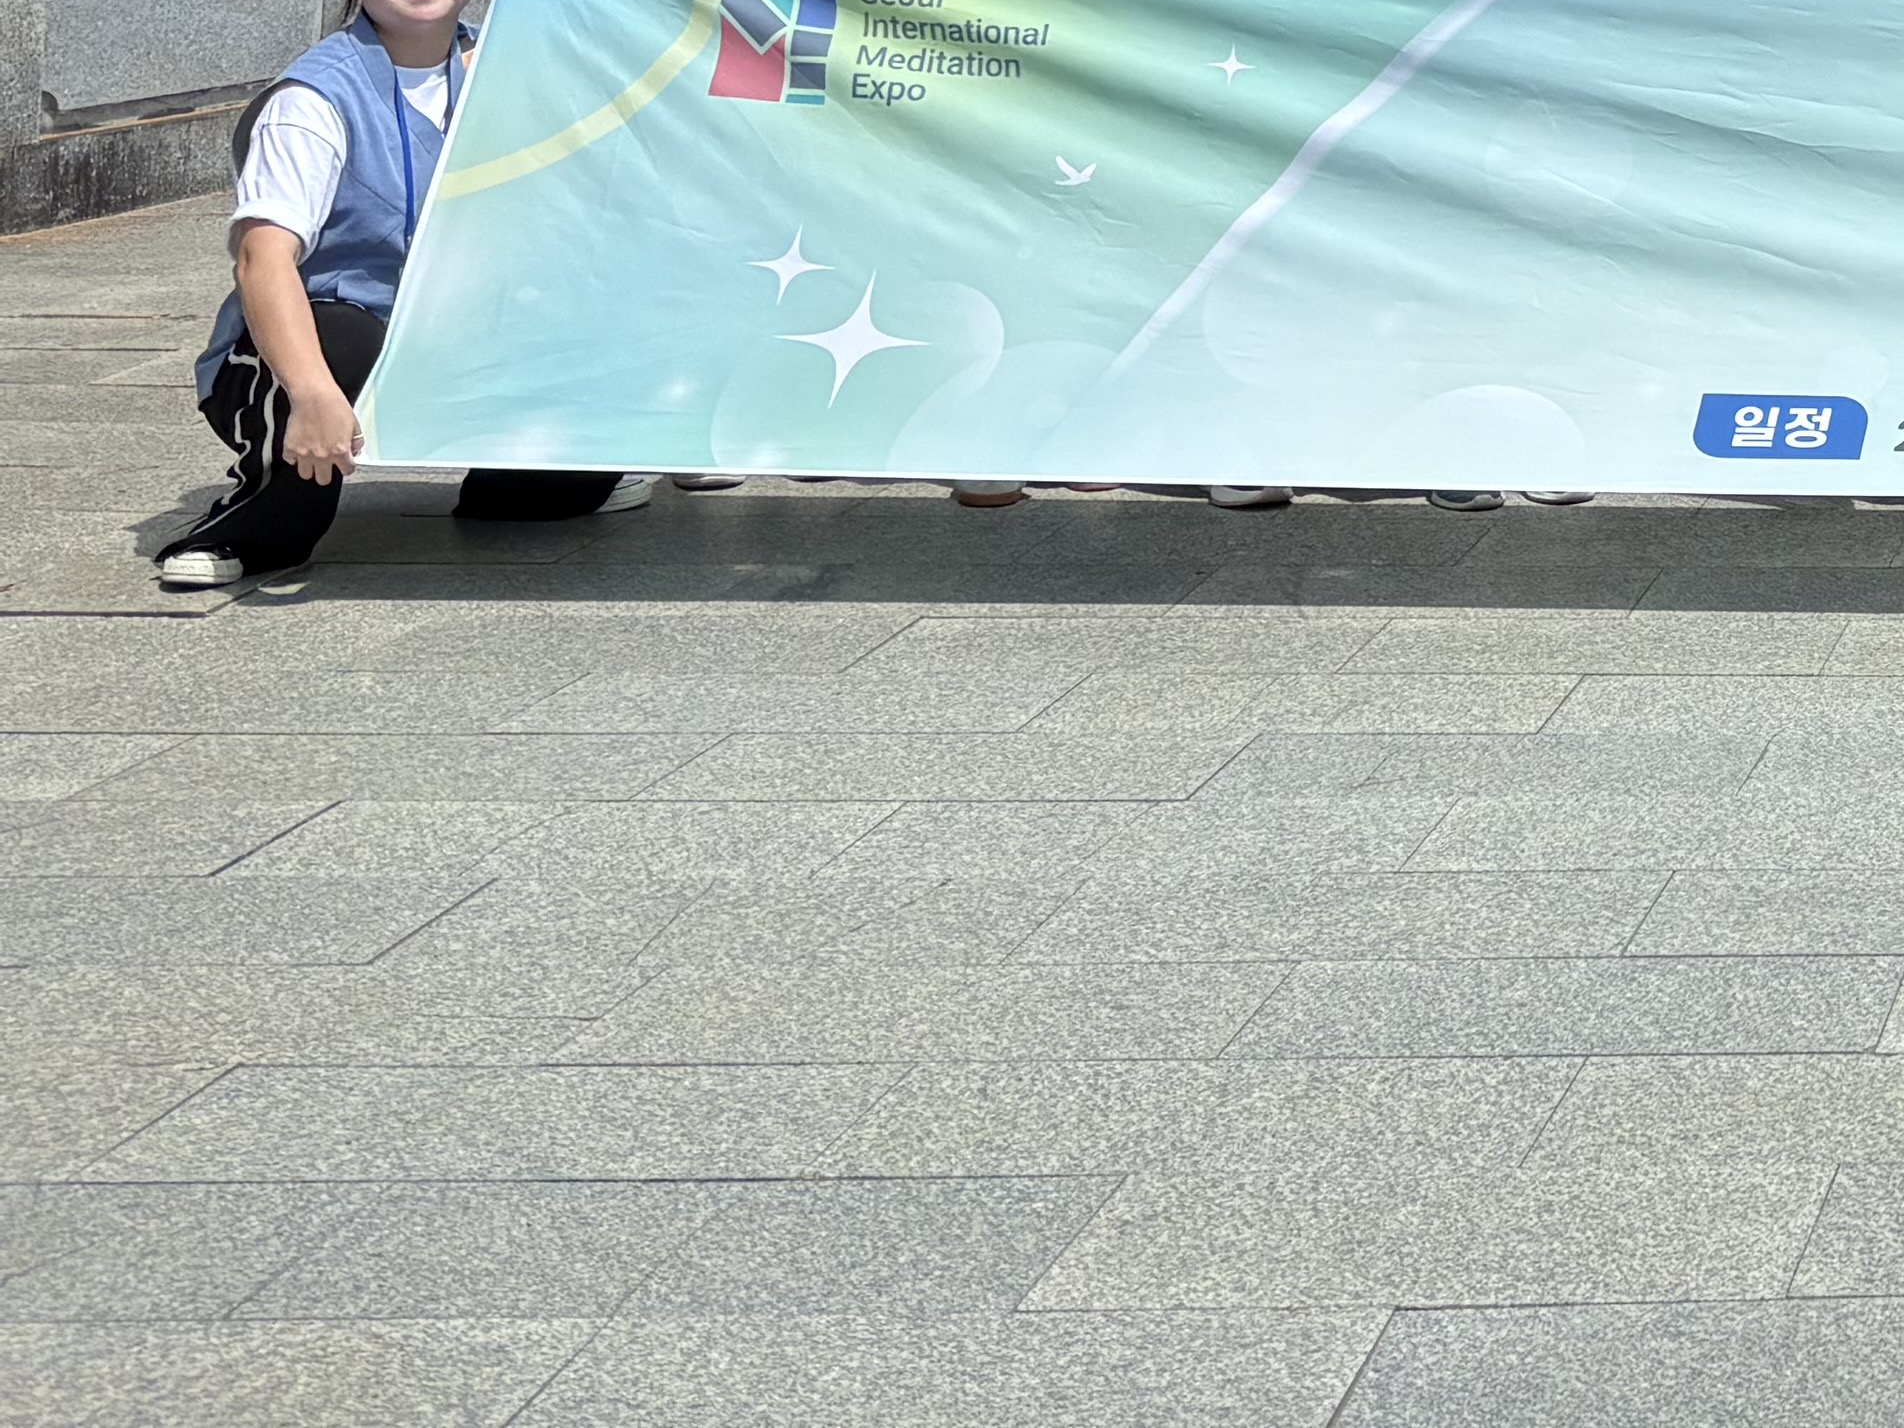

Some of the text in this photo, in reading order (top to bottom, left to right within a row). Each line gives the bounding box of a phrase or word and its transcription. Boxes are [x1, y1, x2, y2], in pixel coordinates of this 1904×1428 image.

[861, 10, 1051, 48] International
[855, 43, 1023, 79] Meditation
[850, 71, 928, 108] Expo
[1730, 405, 1834, 450] 일정
